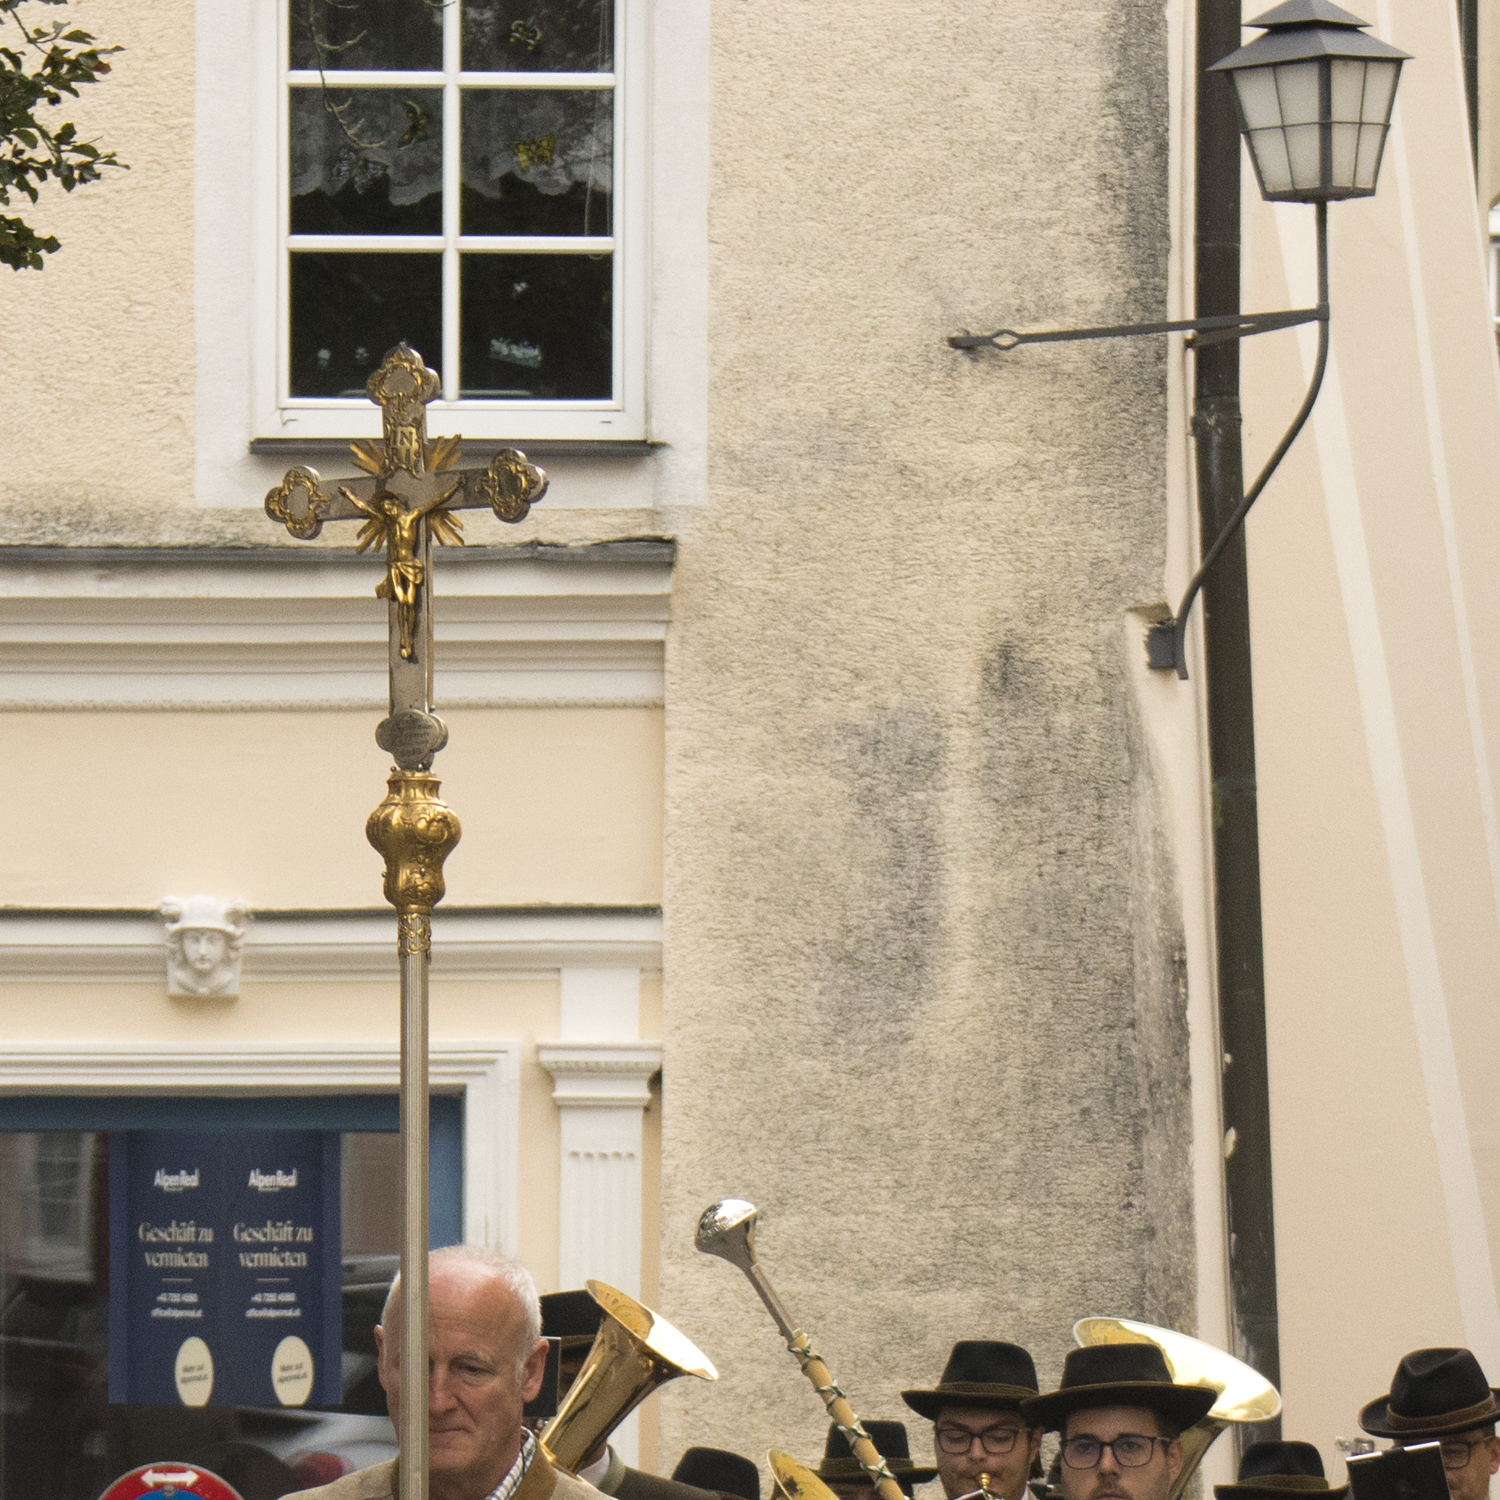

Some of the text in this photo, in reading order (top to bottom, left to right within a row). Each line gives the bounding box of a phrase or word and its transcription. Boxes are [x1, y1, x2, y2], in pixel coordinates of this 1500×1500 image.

[138, 1220, 214, 1242] Geschäft zu
[233, 1220, 314, 1242] Geschäft zu
[144, 1247, 209, 1268] vermieten
[239, 1247, 308, 1268] vermieten
